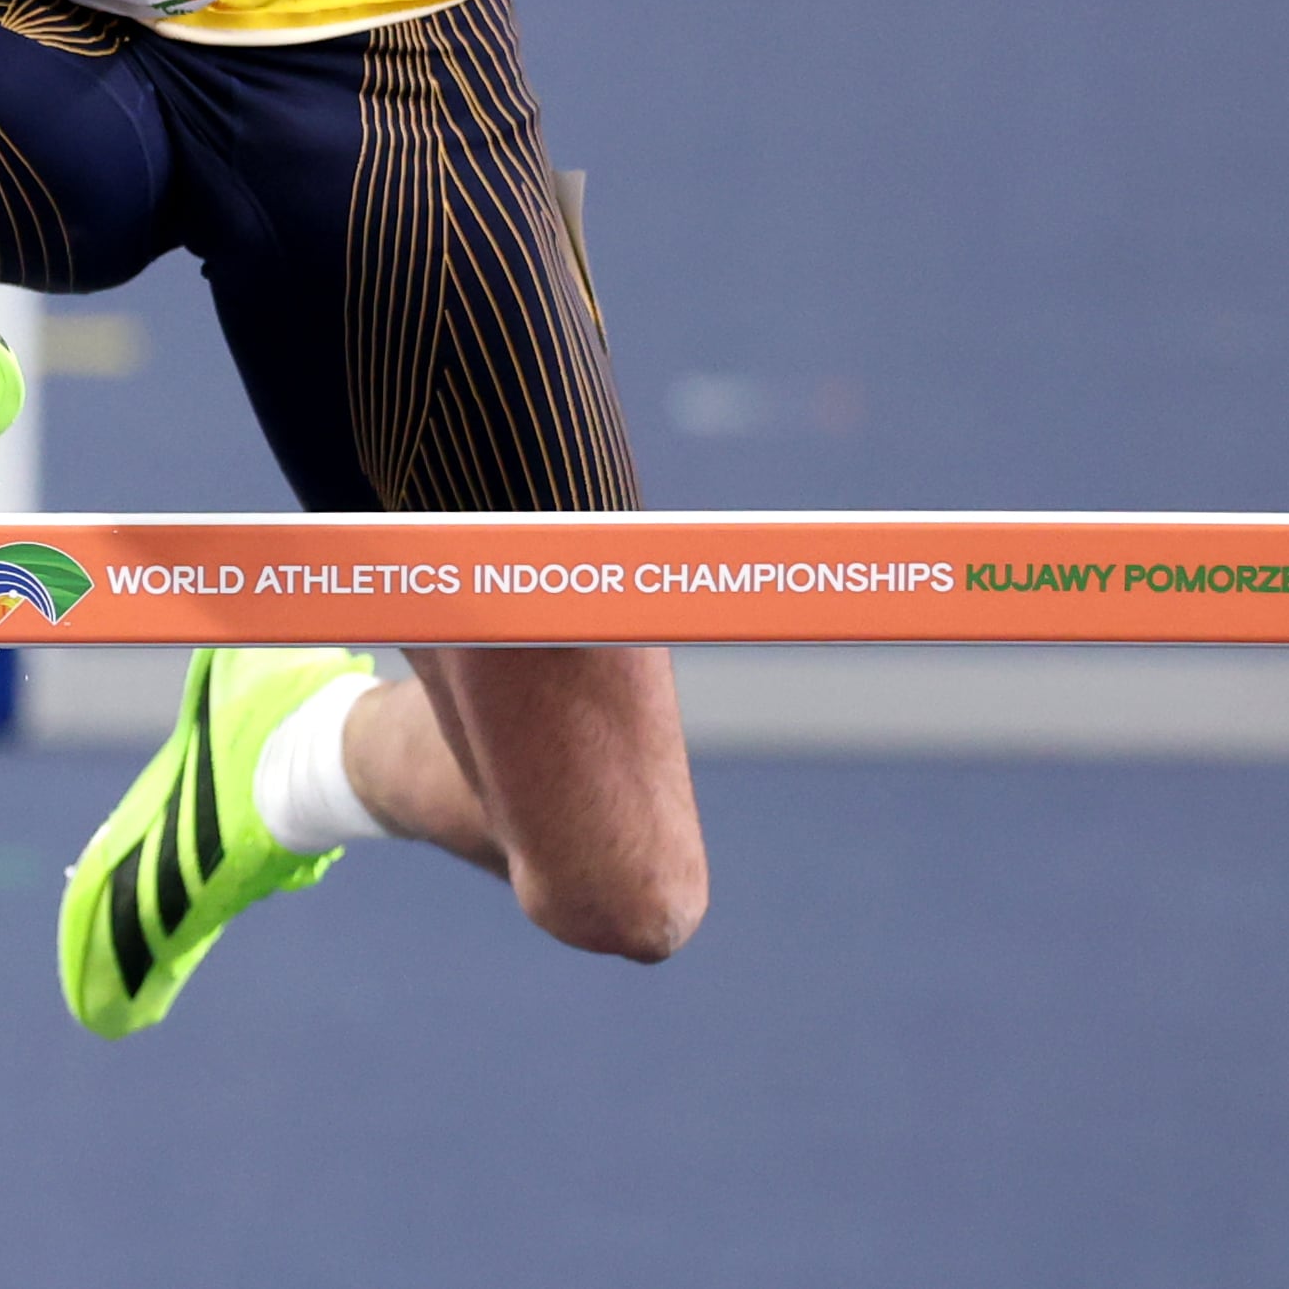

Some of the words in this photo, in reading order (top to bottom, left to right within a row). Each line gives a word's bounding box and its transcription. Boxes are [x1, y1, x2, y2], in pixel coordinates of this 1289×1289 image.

[106, 565, 244, 595] WORLD
[255, 564, 461, 595] ATHLETICS
[475, 563, 625, 594] INDOOR
[635, 562, 955, 594] CHAMPIONSHIPS
[966, 563, 1117, 593] KUJAWY
